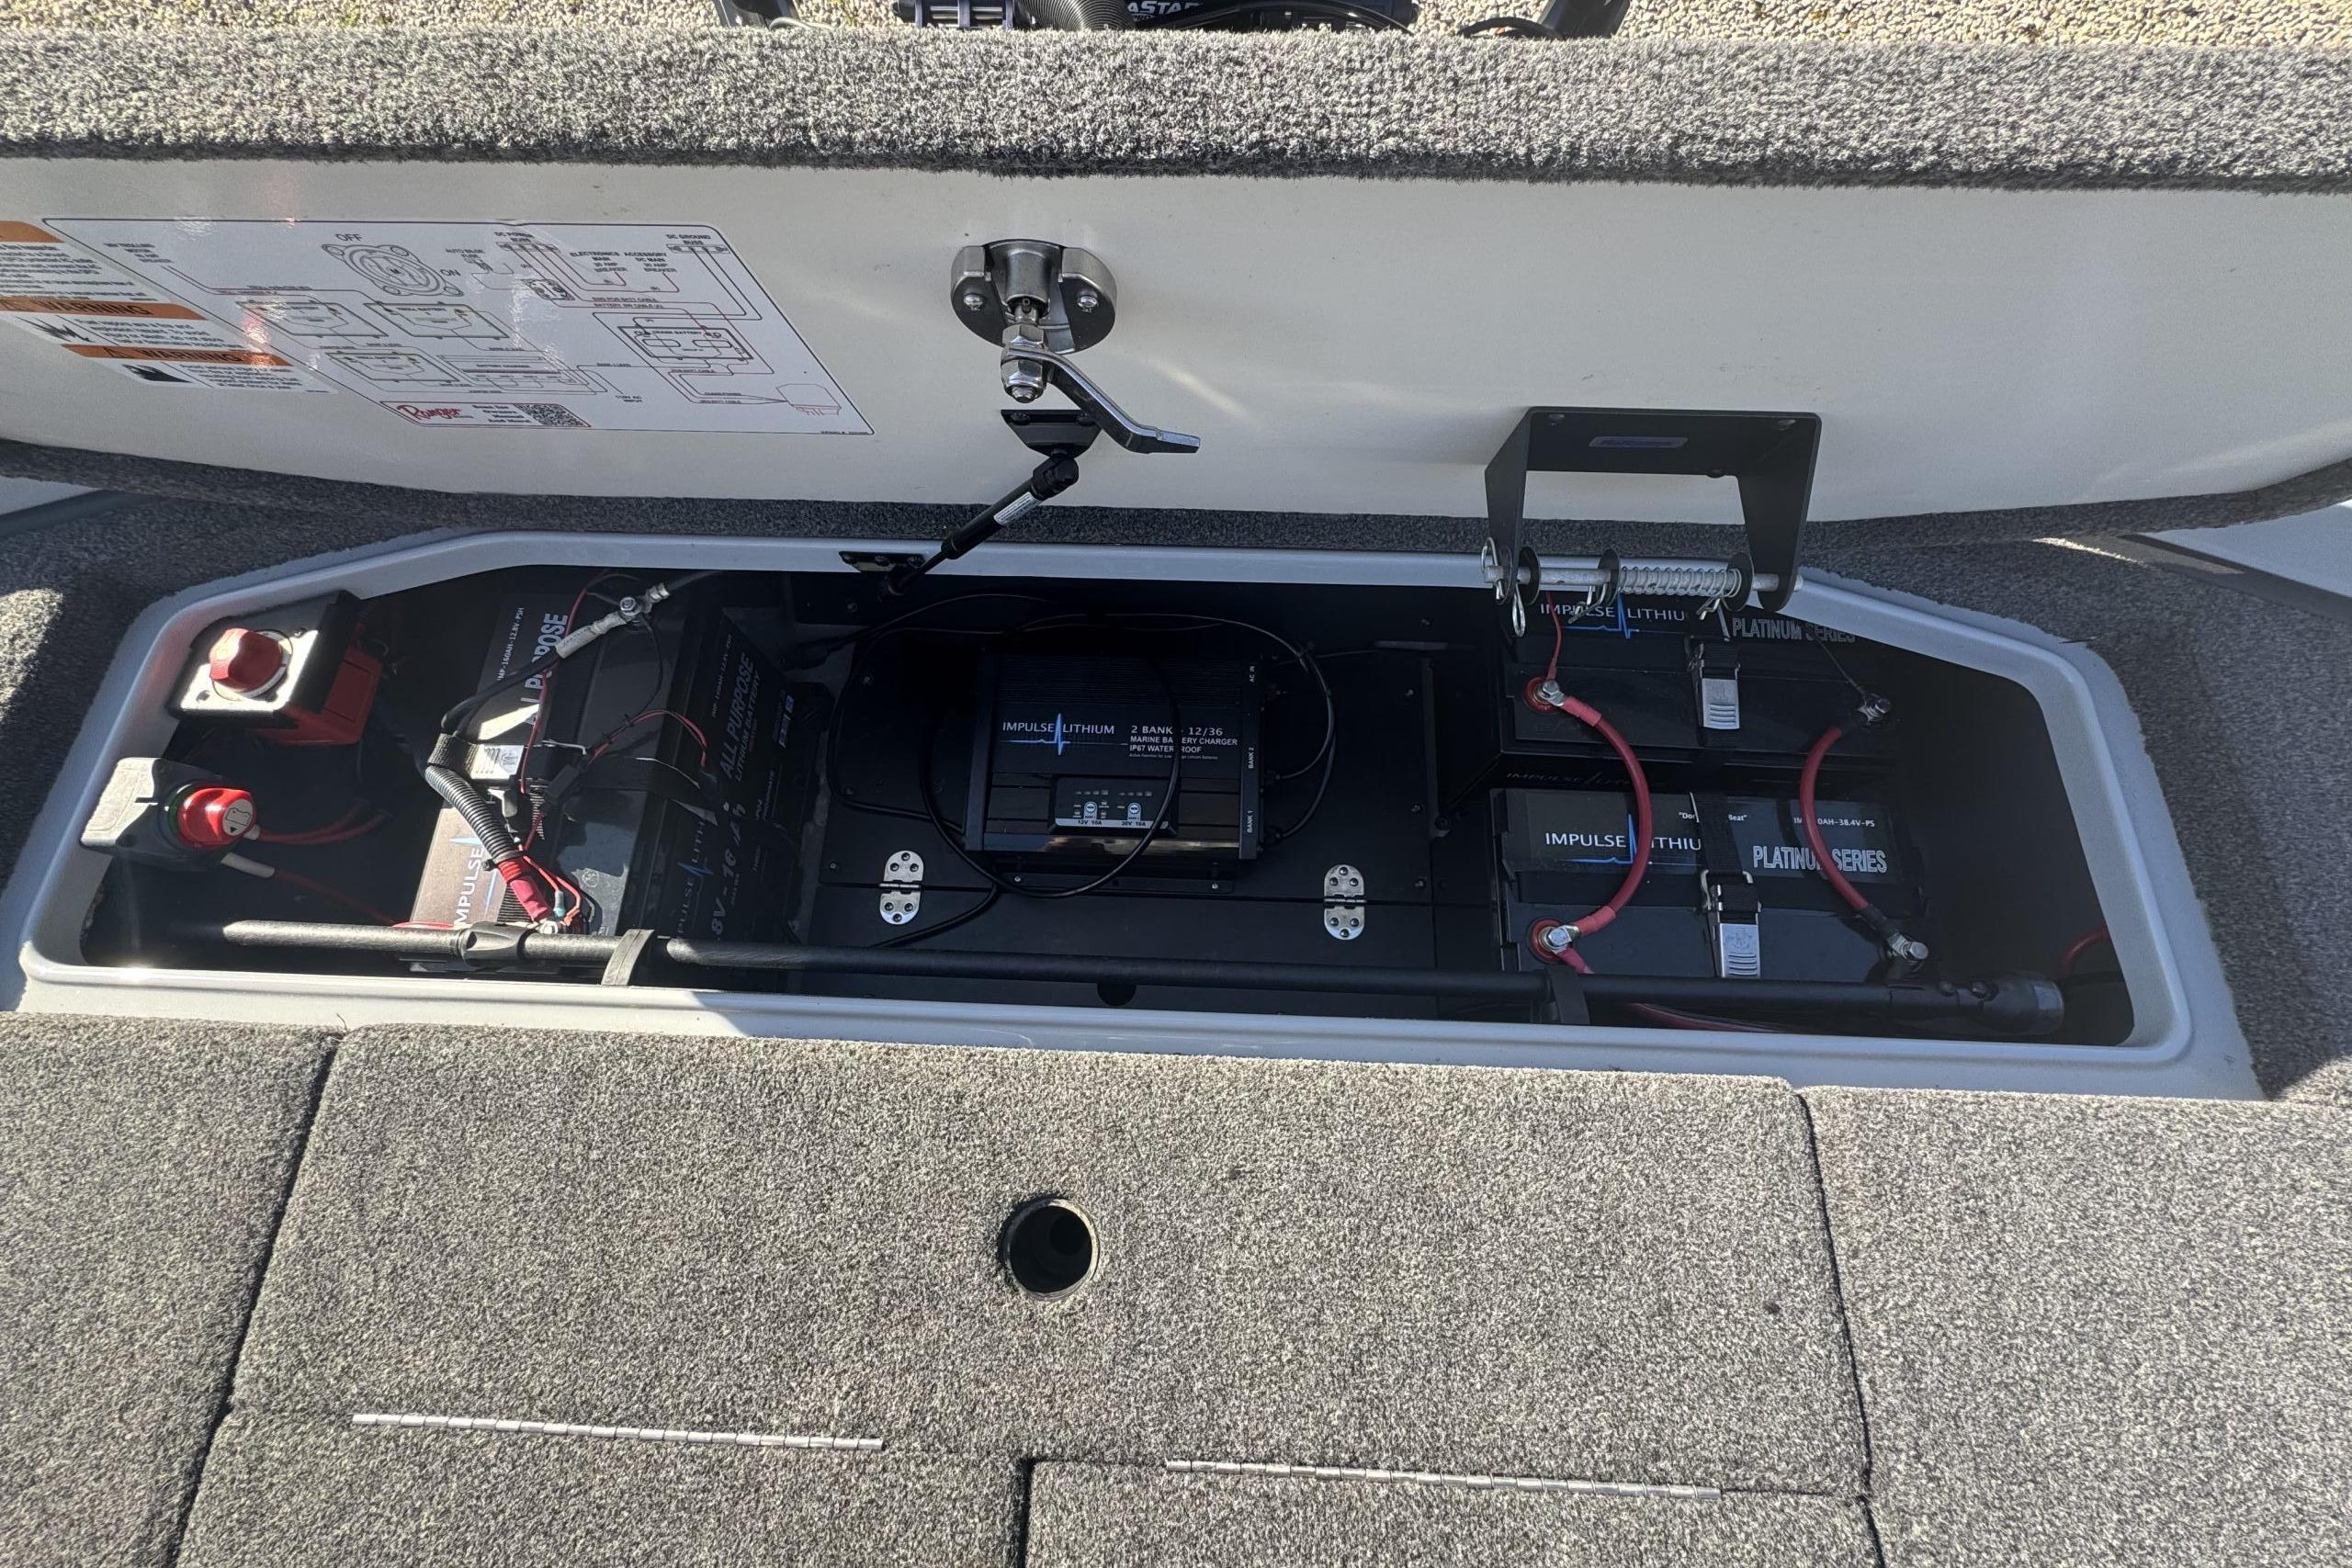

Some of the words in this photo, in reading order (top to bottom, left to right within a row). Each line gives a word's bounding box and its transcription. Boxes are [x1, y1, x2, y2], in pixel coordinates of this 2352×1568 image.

[335, 233, 362, 242] OFF
[440, 268, 461, 276] ON
[397, 404, 463, 420] Ranger
[1627, 607, 1687, 622] LITHIU
[1732, 617, 1804, 640] PLATINUM
[524, 613, 568, 690] PPOSE
[1002, 721, 1054, 733] IMPULSE
[1062, 723, 1114, 735] LITHIUM
[1131, 725, 1138, 734] 2
[1142, 725, 1173, 734] BANK
[1187, 727, 1223, 737] 12/36
[1129, 744, 1145, 753] IP67
[1148, 745, 1202, 754] WATERROOF
[1130, 736, 1160, 744] MARINE
[1162, 736, 1197, 746] BAERY
[1198, 737, 1238, 747] CHARGER
[1545, 832, 1626, 848] IMPULSE
[1648, 838, 1702, 851] ITHIU
[1753, 846, 1821, 871] PLATINU
[1831, 849, 1887, 873] SERIES
[454, 847, 484, 930] MPULSE
